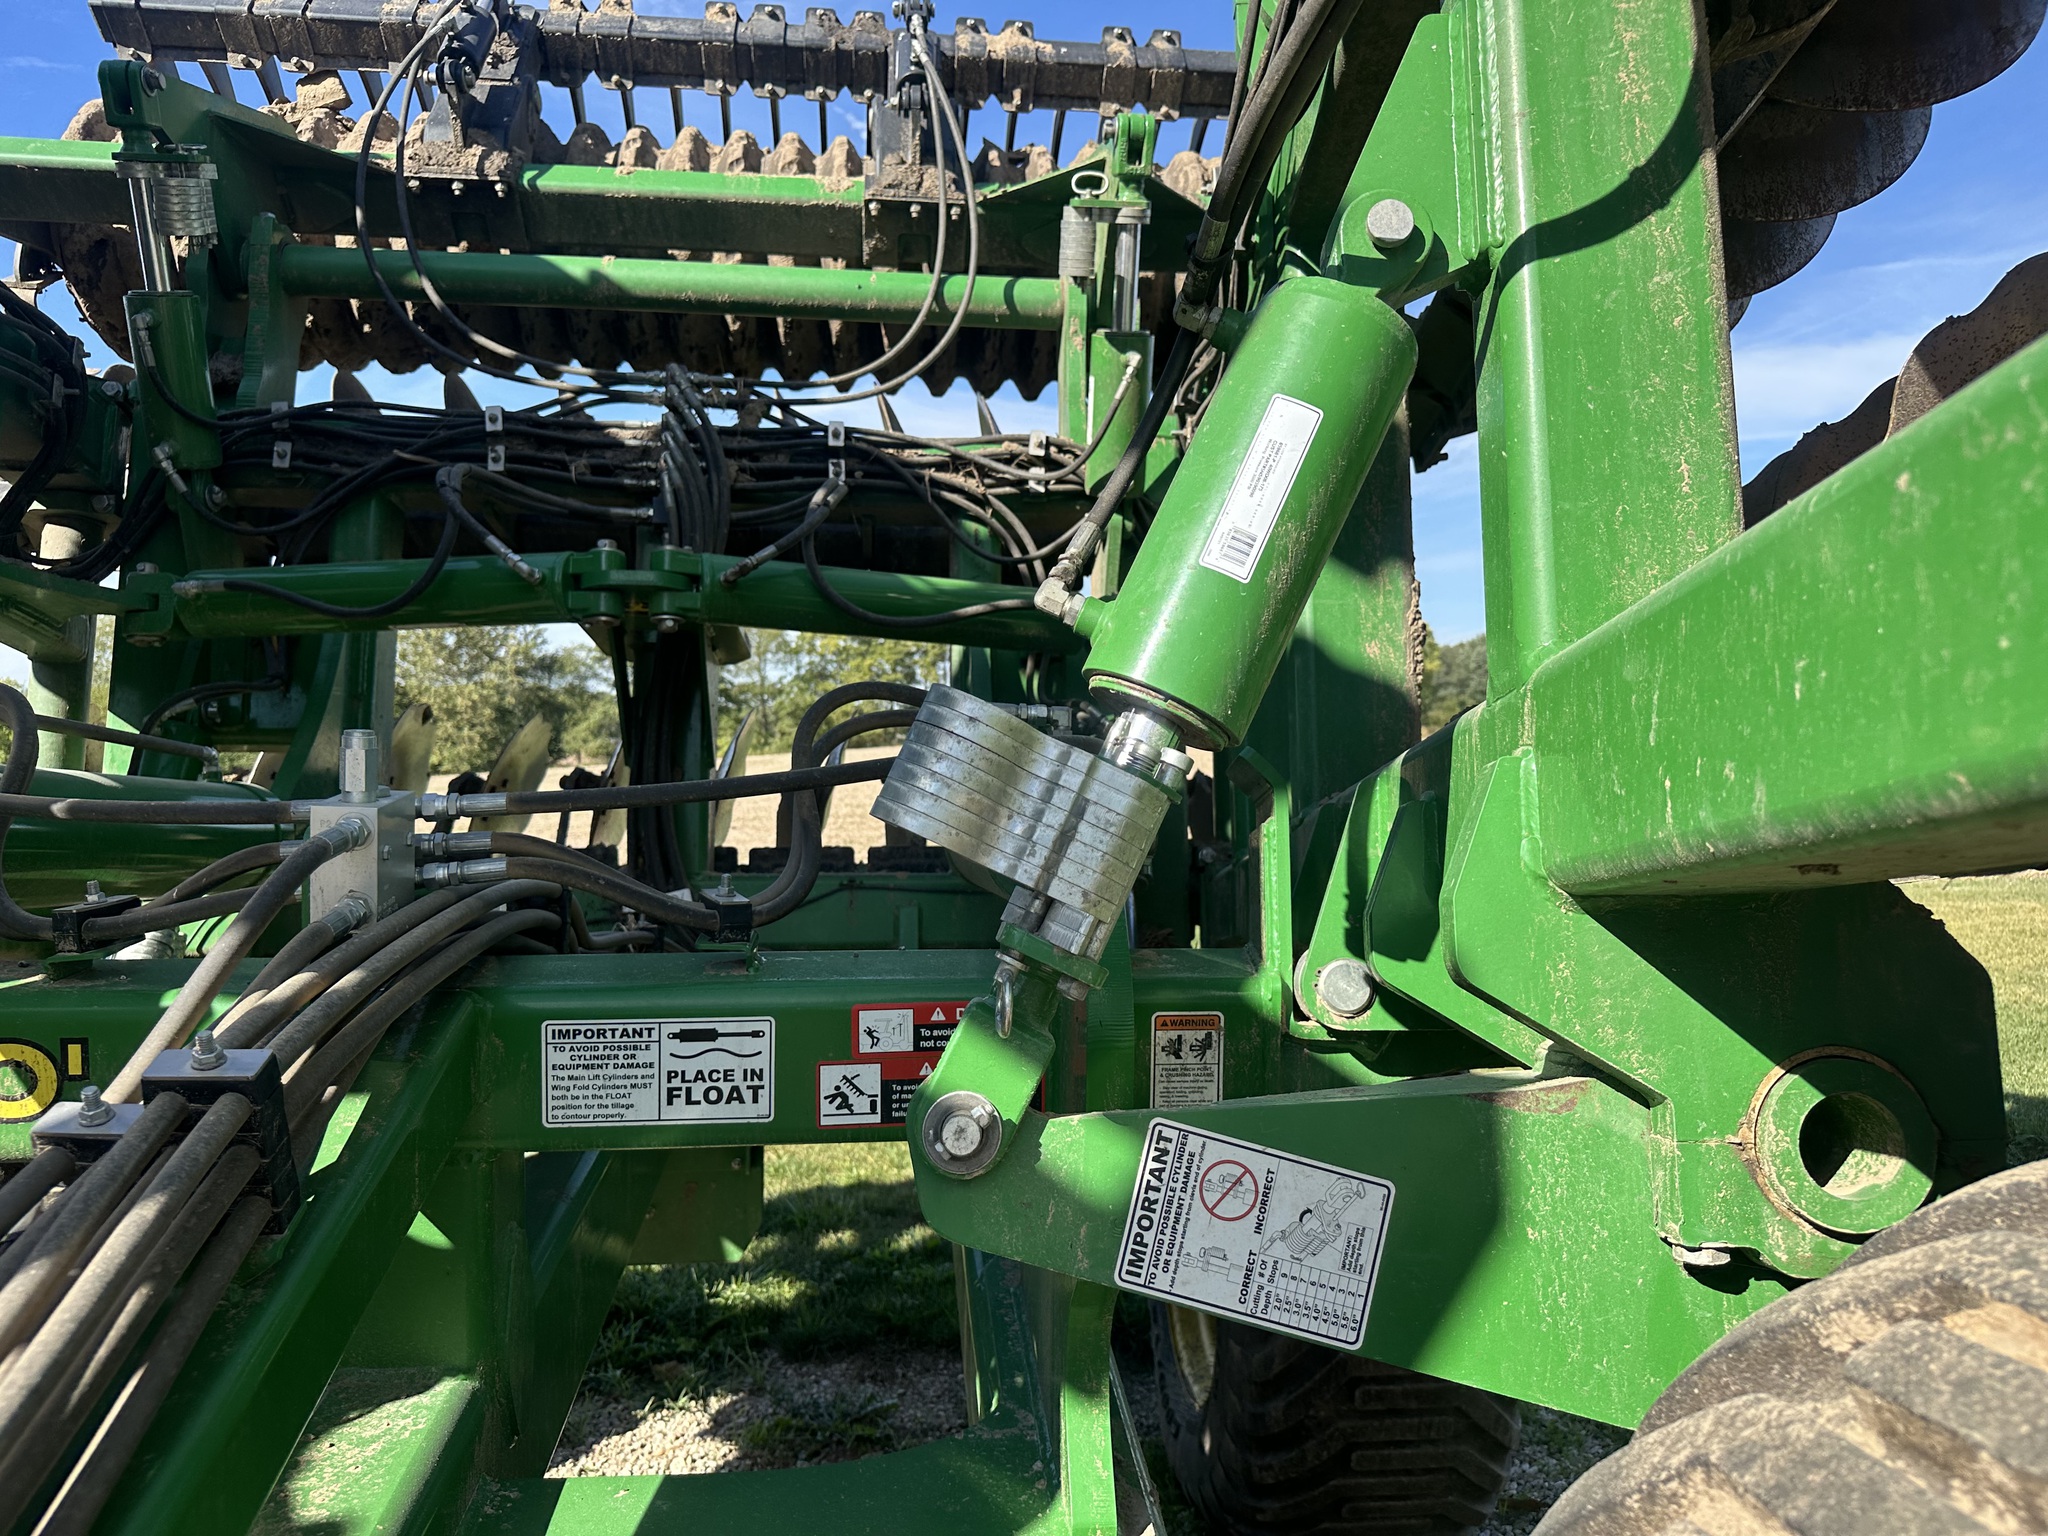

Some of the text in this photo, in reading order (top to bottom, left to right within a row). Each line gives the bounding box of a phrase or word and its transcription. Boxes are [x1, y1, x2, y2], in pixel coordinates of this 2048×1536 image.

[1170, 1019, 1216, 1027] WARNING
[552, 1028, 656, 1040] IMPORTANT
[920, 1028, 930, 1036] To
[552, 1063, 610, 1071] EQUIPMENT
[602, 1073, 638, 1082] Cylinders
[666, 1068, 764, 1084] PLACE IN
[552, 1084, 570, 1092] Wing
[592, 1083, 628, 1091] Cylinders
[666, 1085, 765, 1106] FLOAT
[552, 1103, 582, 1111] position
[611, 1102, 634, 1110] tillage
[592, 1112, 626, 1120] properly.
[1125, 1129, 1172, 1278] IMPORTANT
[1147, 1133, 1188, 1285] TO AVOID POSSIBLE CYLINDER
[1161, 1150, 1195, 1273] OR EQUIPMENT DAMAGE
[1180, 1217, 1190, 1239] starting
[1238, 1167, 1274, 1304] CORRECT INCORRECT
[1250, 1284, 1264, 1314] Cutting
[1259, 1259, 1267, 1270] Of
[1260, 1259, 1278, 1314] Depth Stops
